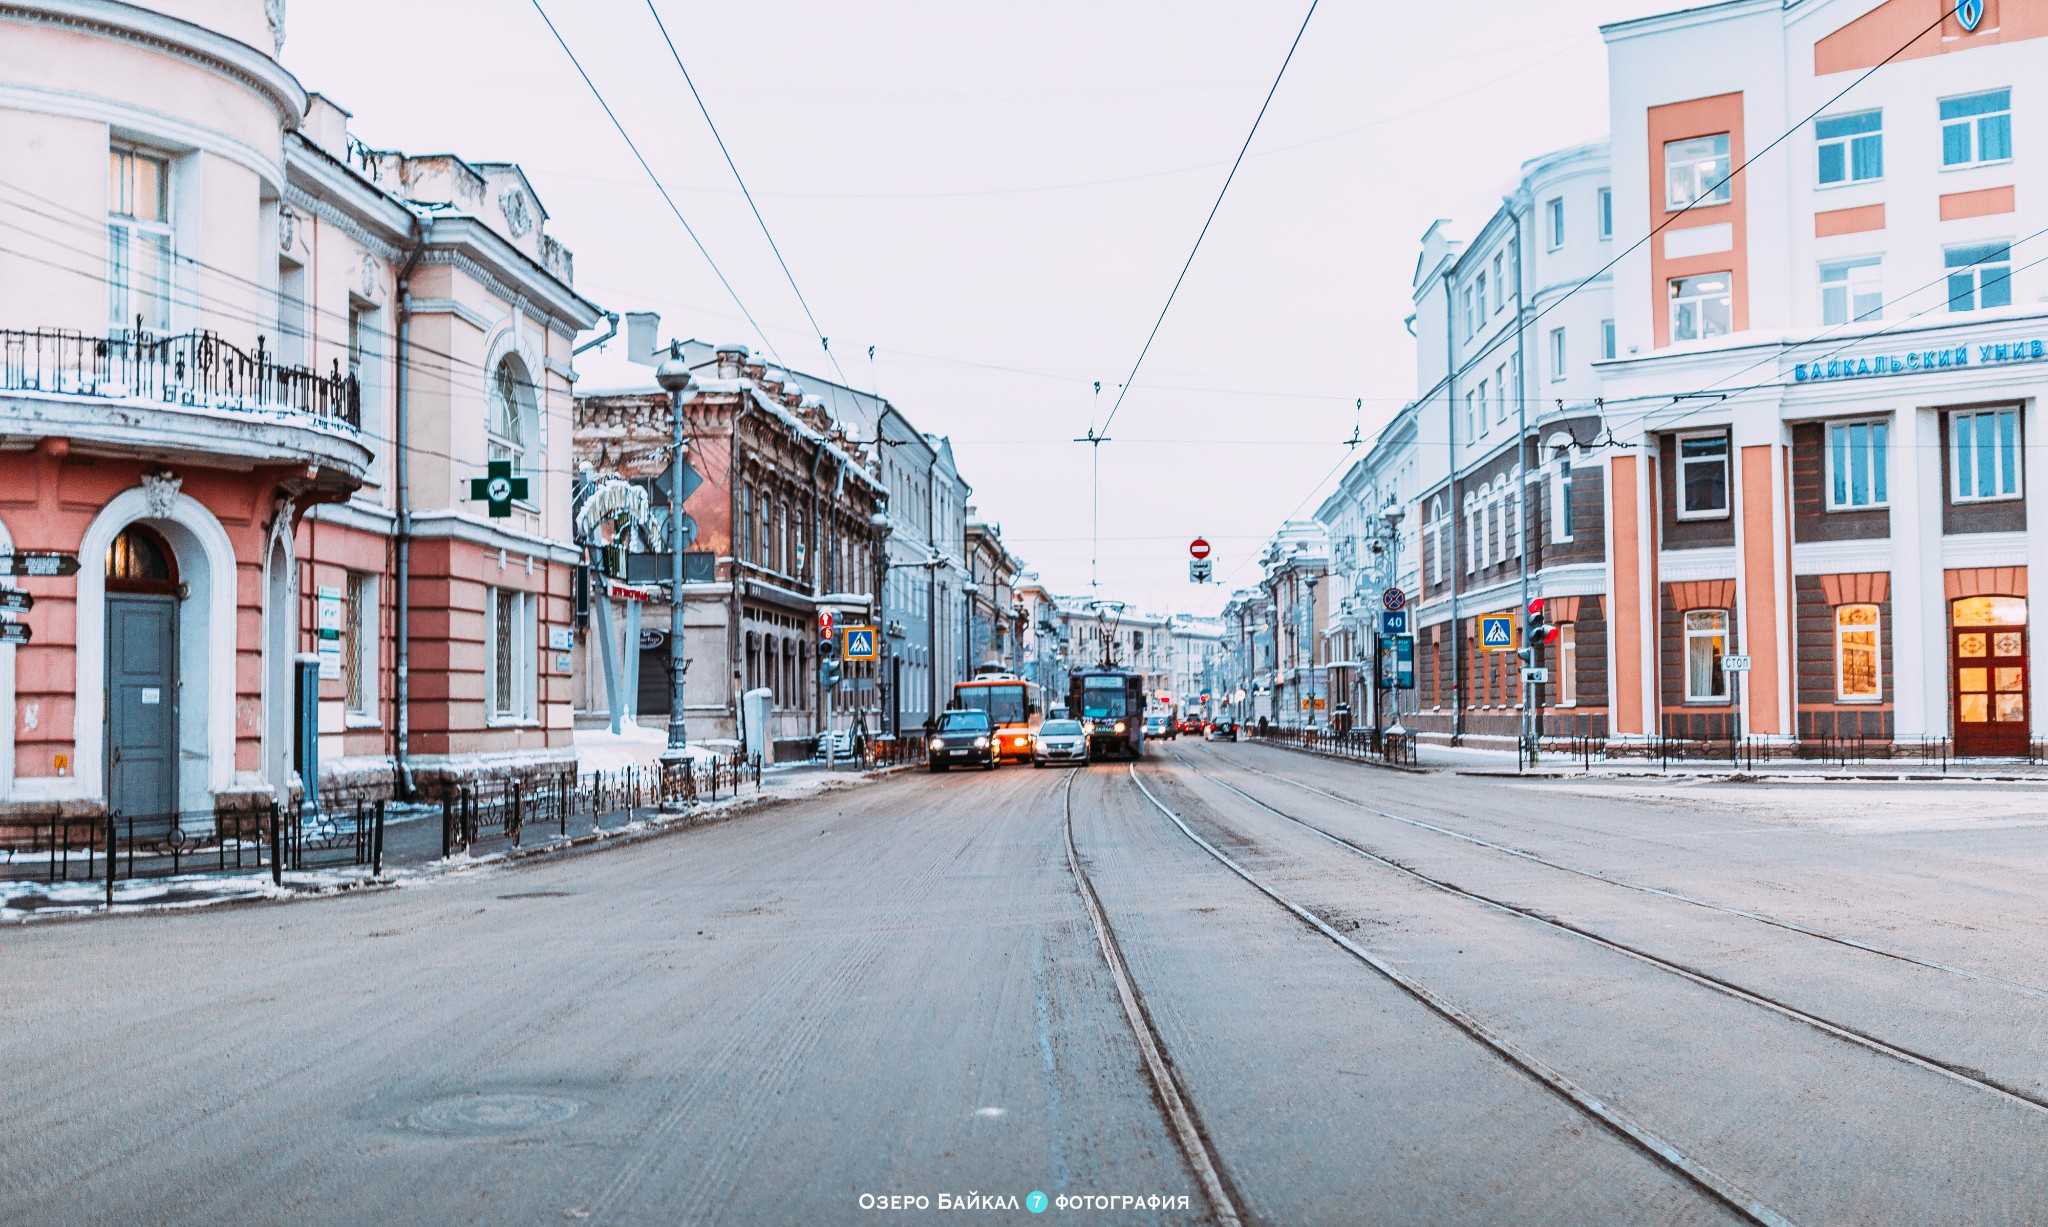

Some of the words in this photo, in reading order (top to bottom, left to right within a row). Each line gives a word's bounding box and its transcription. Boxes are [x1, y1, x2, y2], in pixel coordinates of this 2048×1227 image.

[1793, 345, 1968, 382] БАЙКАЛЬСКИЙ
[1979, 339, 2044, 362] УНИВ
[1387, 616, 1403, 628] 40
[1725, 658, 1749, 669] СТОП
